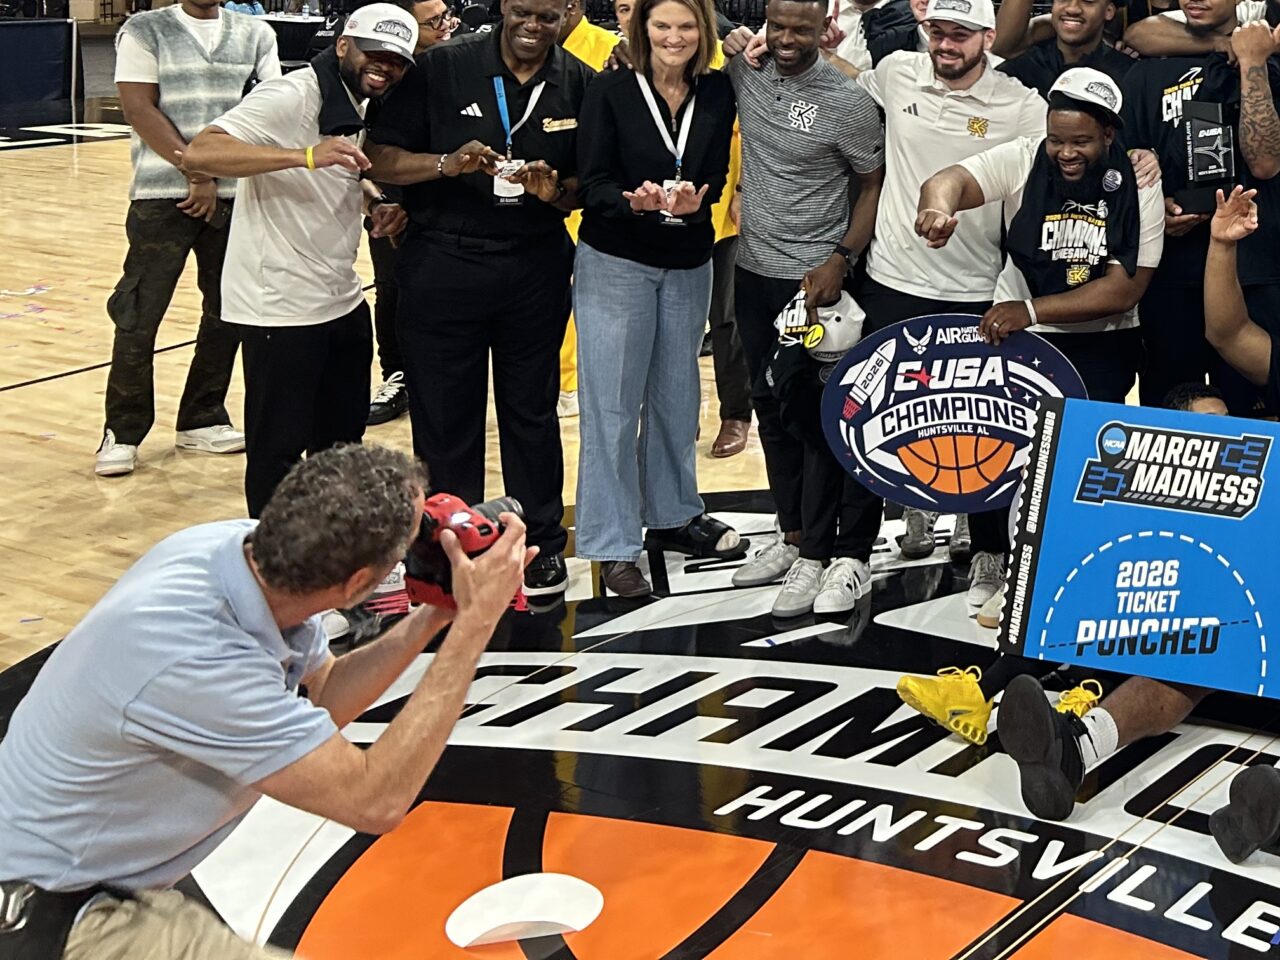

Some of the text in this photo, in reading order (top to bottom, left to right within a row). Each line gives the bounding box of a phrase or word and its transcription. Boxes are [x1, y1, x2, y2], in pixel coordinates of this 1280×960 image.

[936, 326, 962, 345] AIR
[859, 358, 886, 391] 2026
[880, 396, 1033, 439] CHAMPIONS
[918, 423, 990, 439] HUNTSVILLE AL
[1104, 438, 1128, 451] NCAA
[1124, 431, 1222, 470] MARCH
[1026, 409, 1057, 534] @MARCHMADNESSMBB
[1130, 461, 1259, 507] MADNESS
[1115, 559, 1181, 589] 2026
[1008, 543, 1034, 645] #MARCHMADNESS
[1117, 590, 1182, 614] TICKET
[1075, 617, 1222, 657] PUNCHED
